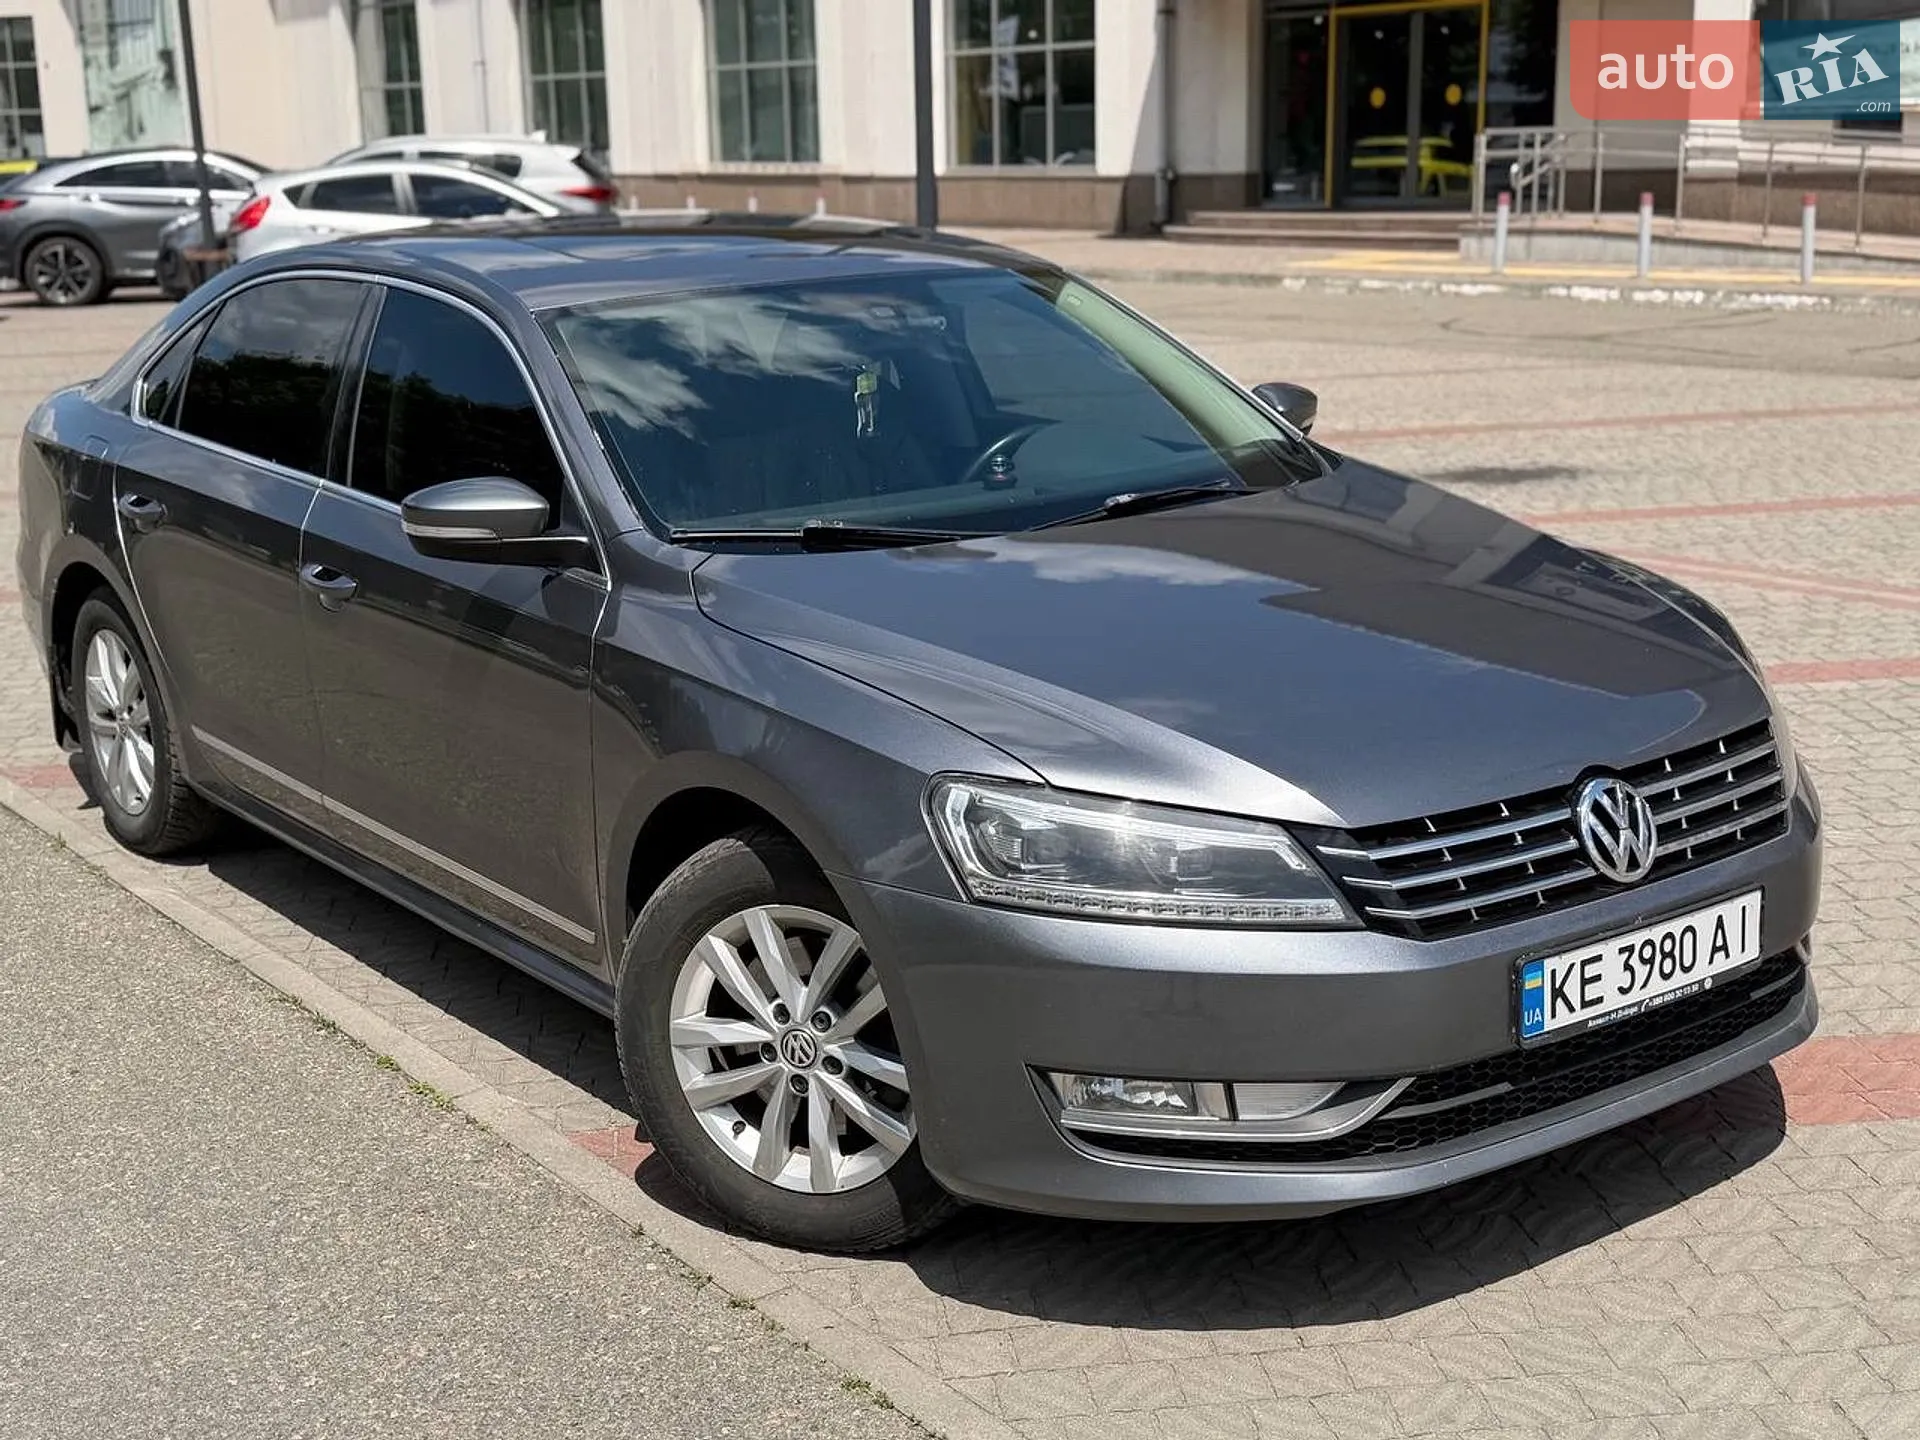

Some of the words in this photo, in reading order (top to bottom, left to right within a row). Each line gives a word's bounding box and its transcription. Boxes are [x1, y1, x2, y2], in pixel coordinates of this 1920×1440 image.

[1550, 954, 1604, 1020] KE
[1617, 925, 1697, 996] 3980
[1708, 904, 1747, 966] AI
[1524, 1007, 1543, 1027] UA
